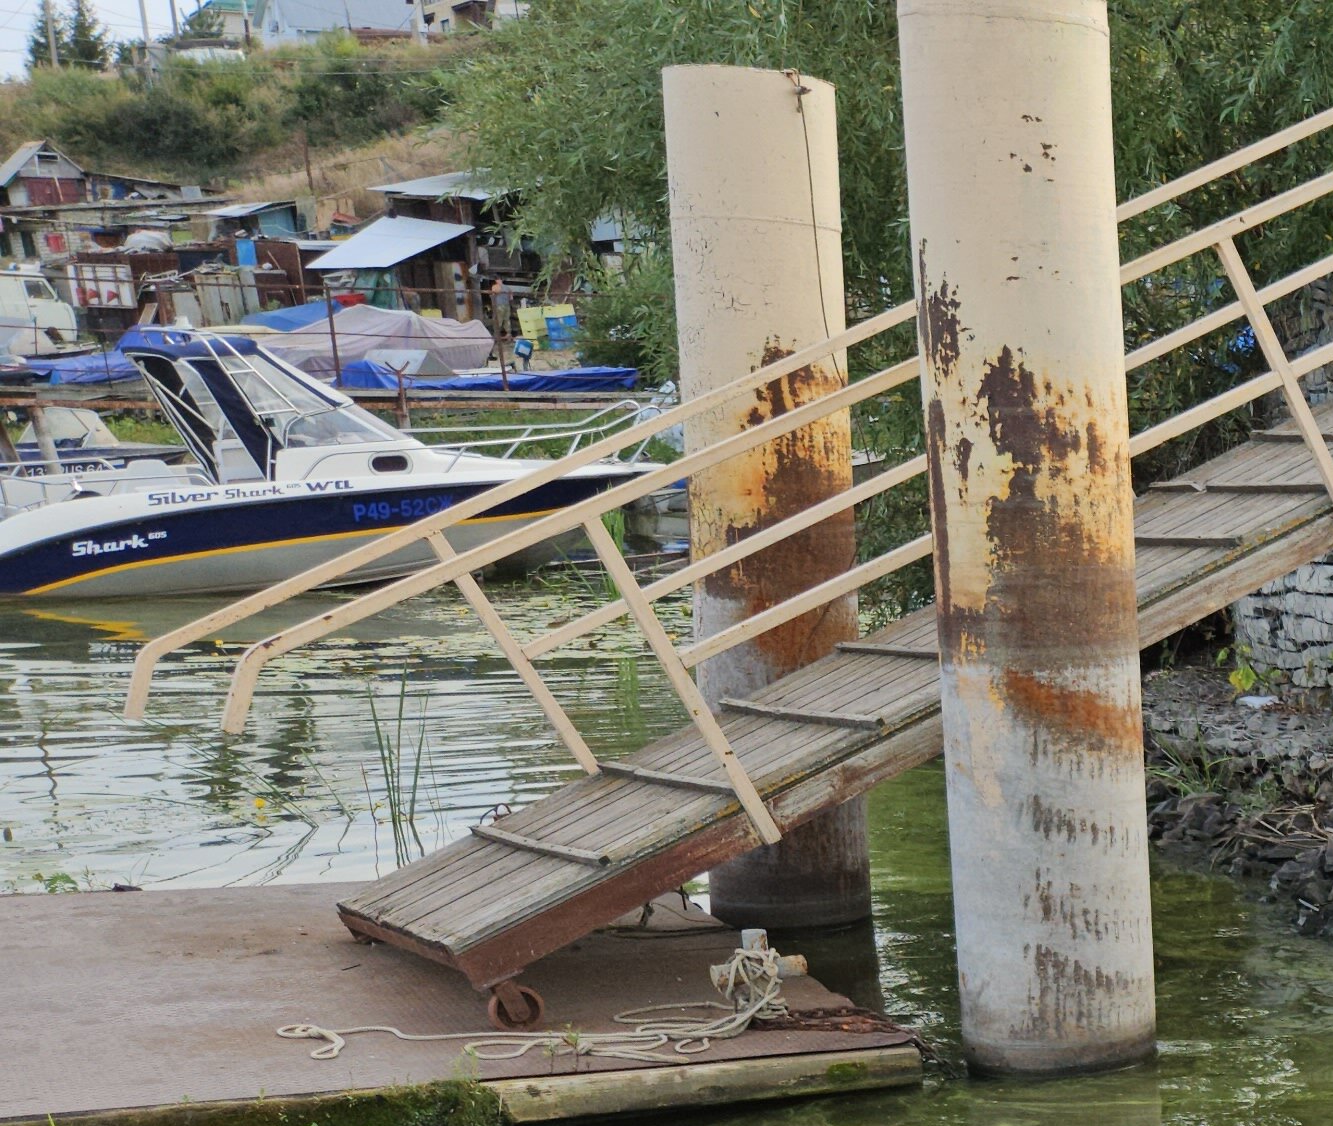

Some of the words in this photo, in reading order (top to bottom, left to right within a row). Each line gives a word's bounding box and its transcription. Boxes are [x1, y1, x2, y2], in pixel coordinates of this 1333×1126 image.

[148, 491, 219, 506] Silver
[224, 486, 285, 500] Shark
[72, 534, 149, 557] Shark
